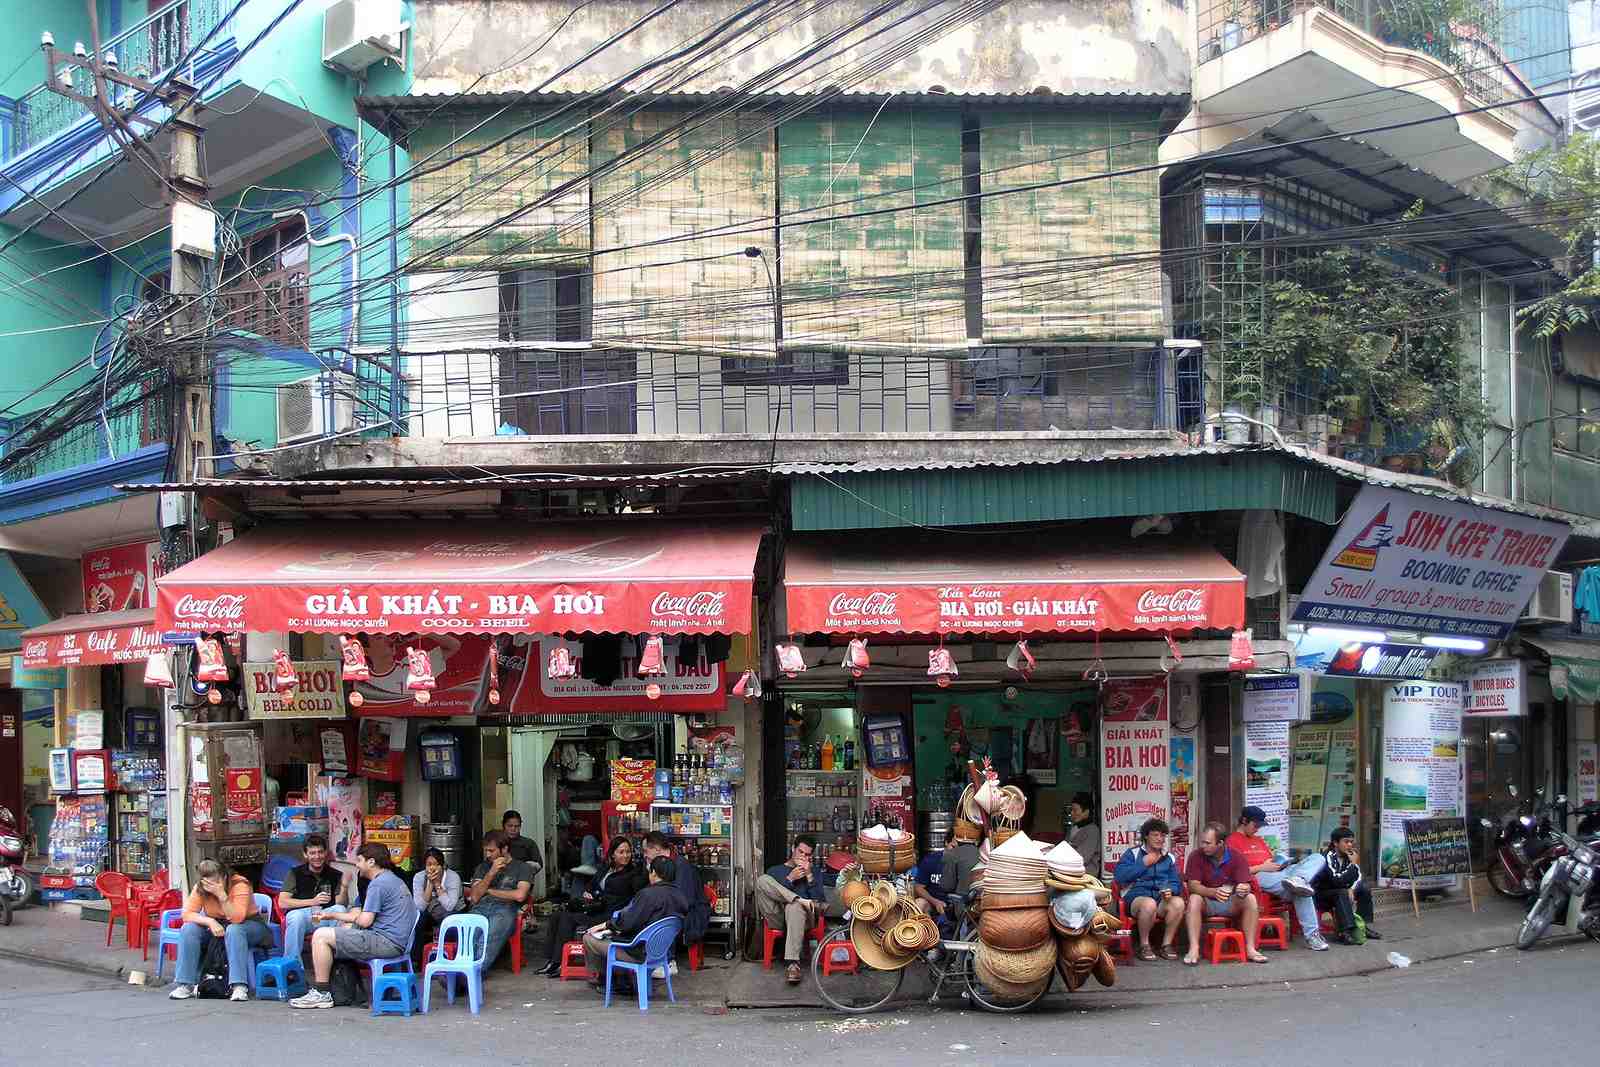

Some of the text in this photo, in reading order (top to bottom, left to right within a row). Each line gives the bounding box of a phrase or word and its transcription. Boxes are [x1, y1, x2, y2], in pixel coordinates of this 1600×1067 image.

[1396, 511, 1452, 553] SINH
[1493, 527, 1556, 568] TRAVEL
[1400, 559, 1471, 585] BOOKING
[1472, 570, 1521, 592] OFFICE
[175, 593, 248, 618] Coca-Cola
[306, 589, 368, 614] GIẢI
[380, 589, 463, 615] KHÁT
[488, 595, 540, 614] BIA
[651, 592, 727, 616] Coca-Cola
[829, 592, 898, 615] Coca-Cola
[940, 602, 969, 616] BIA
[1052, 596, 1098, 615] KHÁT
[1137, 588, 1205, 612] Coca-Cola
[1325, 577, 1374, 599] Small
[1371, 588, 1420, 608] group
[1430, 593, 1483, 613] private
[1487, 600, 1515, 616] tour
[421, 618, 473, 627] COOL
[88, 629, 117, 654] Café
[1392, 686, 1458, 698] VIP TOUR
[1476, 694, 1505, 707] BICYCLES
[263, 698, 332, 712] BEER COLD
[1105, 746, 1134, 768] BIA
[1109, 774, 1138, 791] 2000
